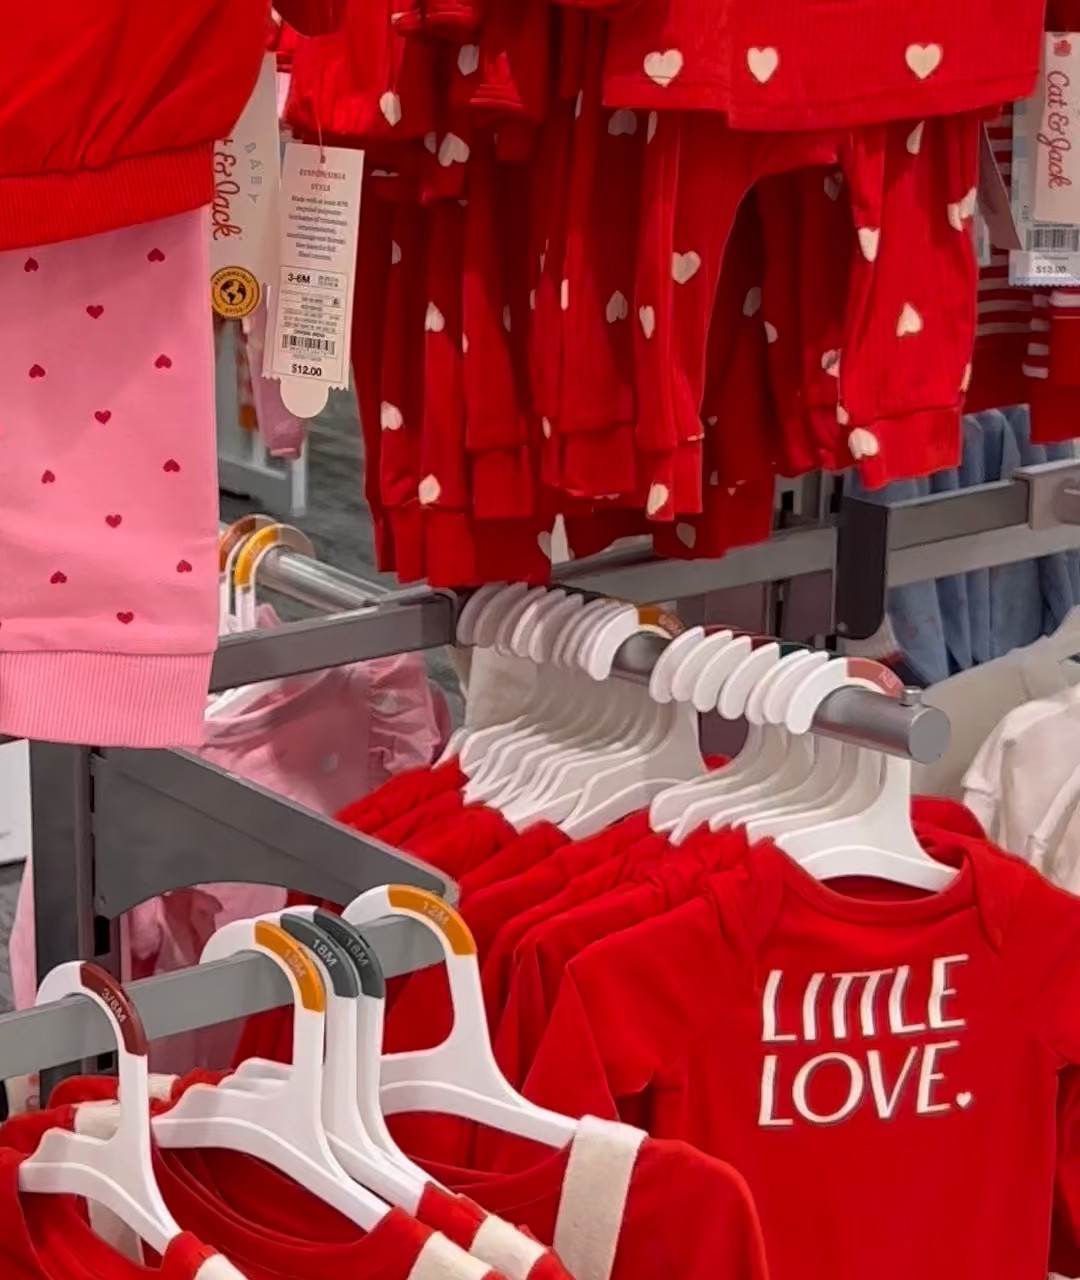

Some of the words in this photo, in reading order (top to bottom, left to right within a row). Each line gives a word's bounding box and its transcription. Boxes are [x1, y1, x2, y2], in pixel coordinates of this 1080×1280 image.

[1047, 71, 1070, 108] Cat
[1048, 111, 1069, 135] &
[1036, 132, 1072, 190] Jack
[288, 272, 311, 284] 3-6M
[291, 363, 322, 377] $12.00
[312, 939, 338, 967] 18M
[761, 953, 969, 1042] LITTLE
